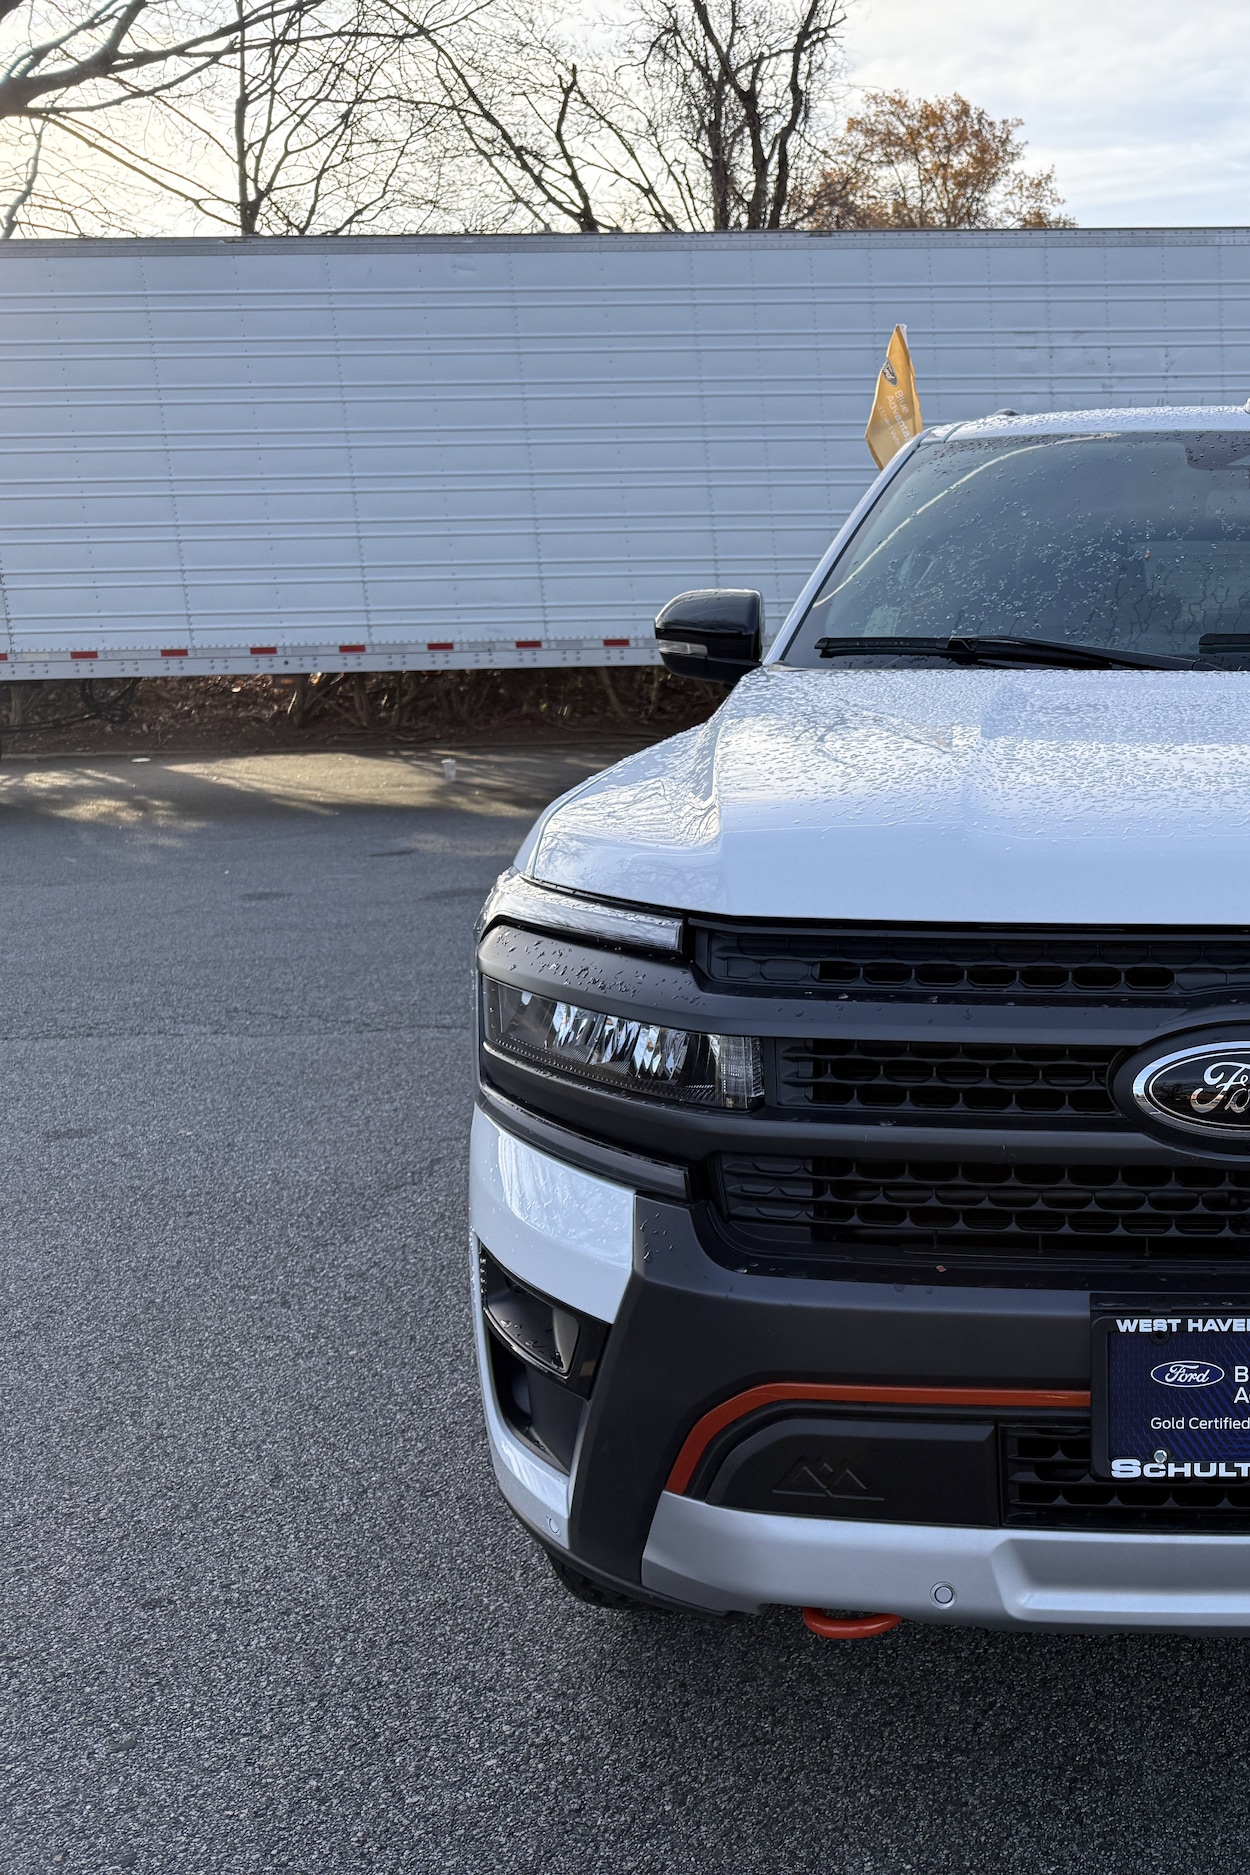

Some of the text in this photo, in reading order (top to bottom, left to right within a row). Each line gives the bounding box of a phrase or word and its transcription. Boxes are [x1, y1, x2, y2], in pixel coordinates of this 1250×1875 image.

[894, 389, 909, 414] Blue
[1116, 1319, 1181, 1332] WEST
[1164, 1364, 1210, 1384] Ford
[1150, 1417, 1185, 1430] Gold
[1188, 1417, 1250, 1430] Certified
